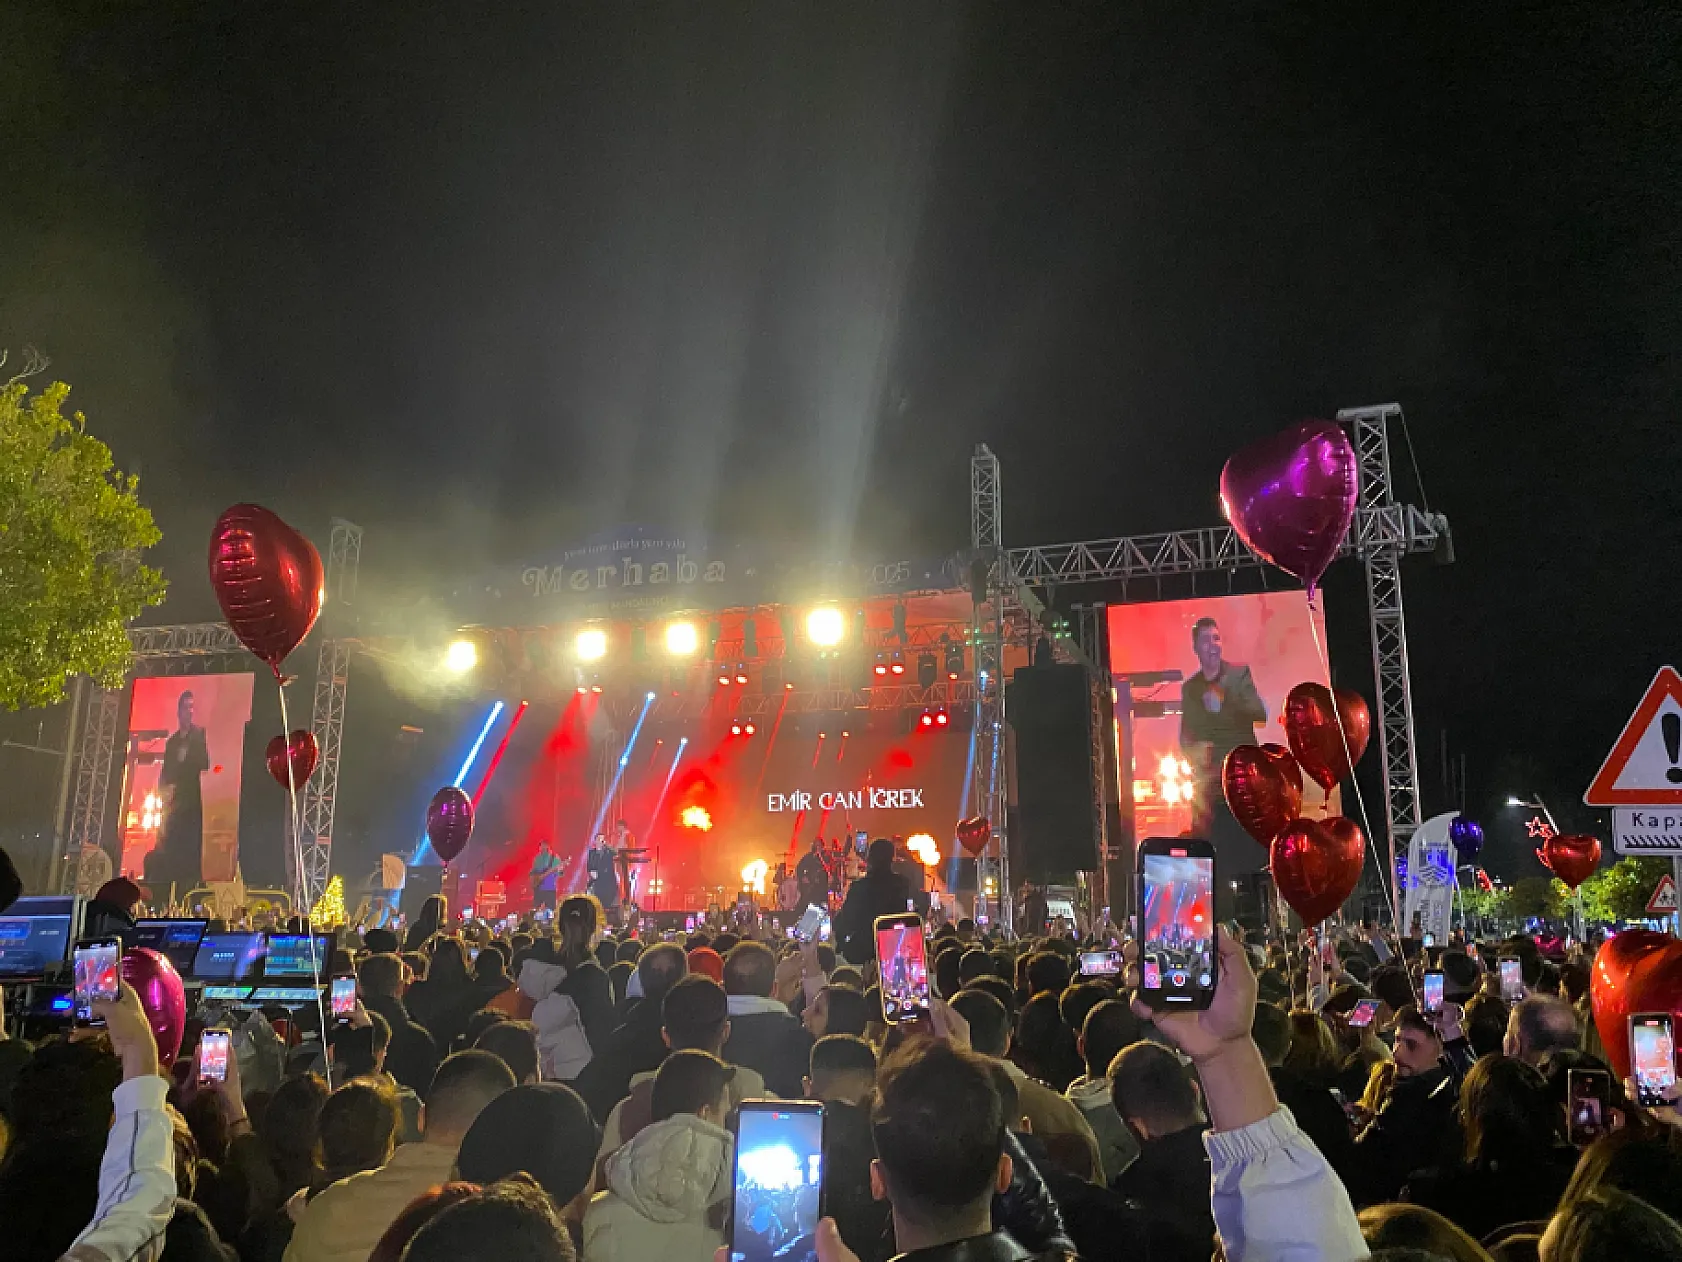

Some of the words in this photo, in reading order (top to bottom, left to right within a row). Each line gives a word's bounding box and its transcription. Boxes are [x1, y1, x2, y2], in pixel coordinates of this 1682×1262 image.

[521, 553, 726, 597] Merhaba
[768, 788, 812, 811] EMİR
[818, 789, 862, 810] CAN
[1631, 810, 1682, 832] Kap
